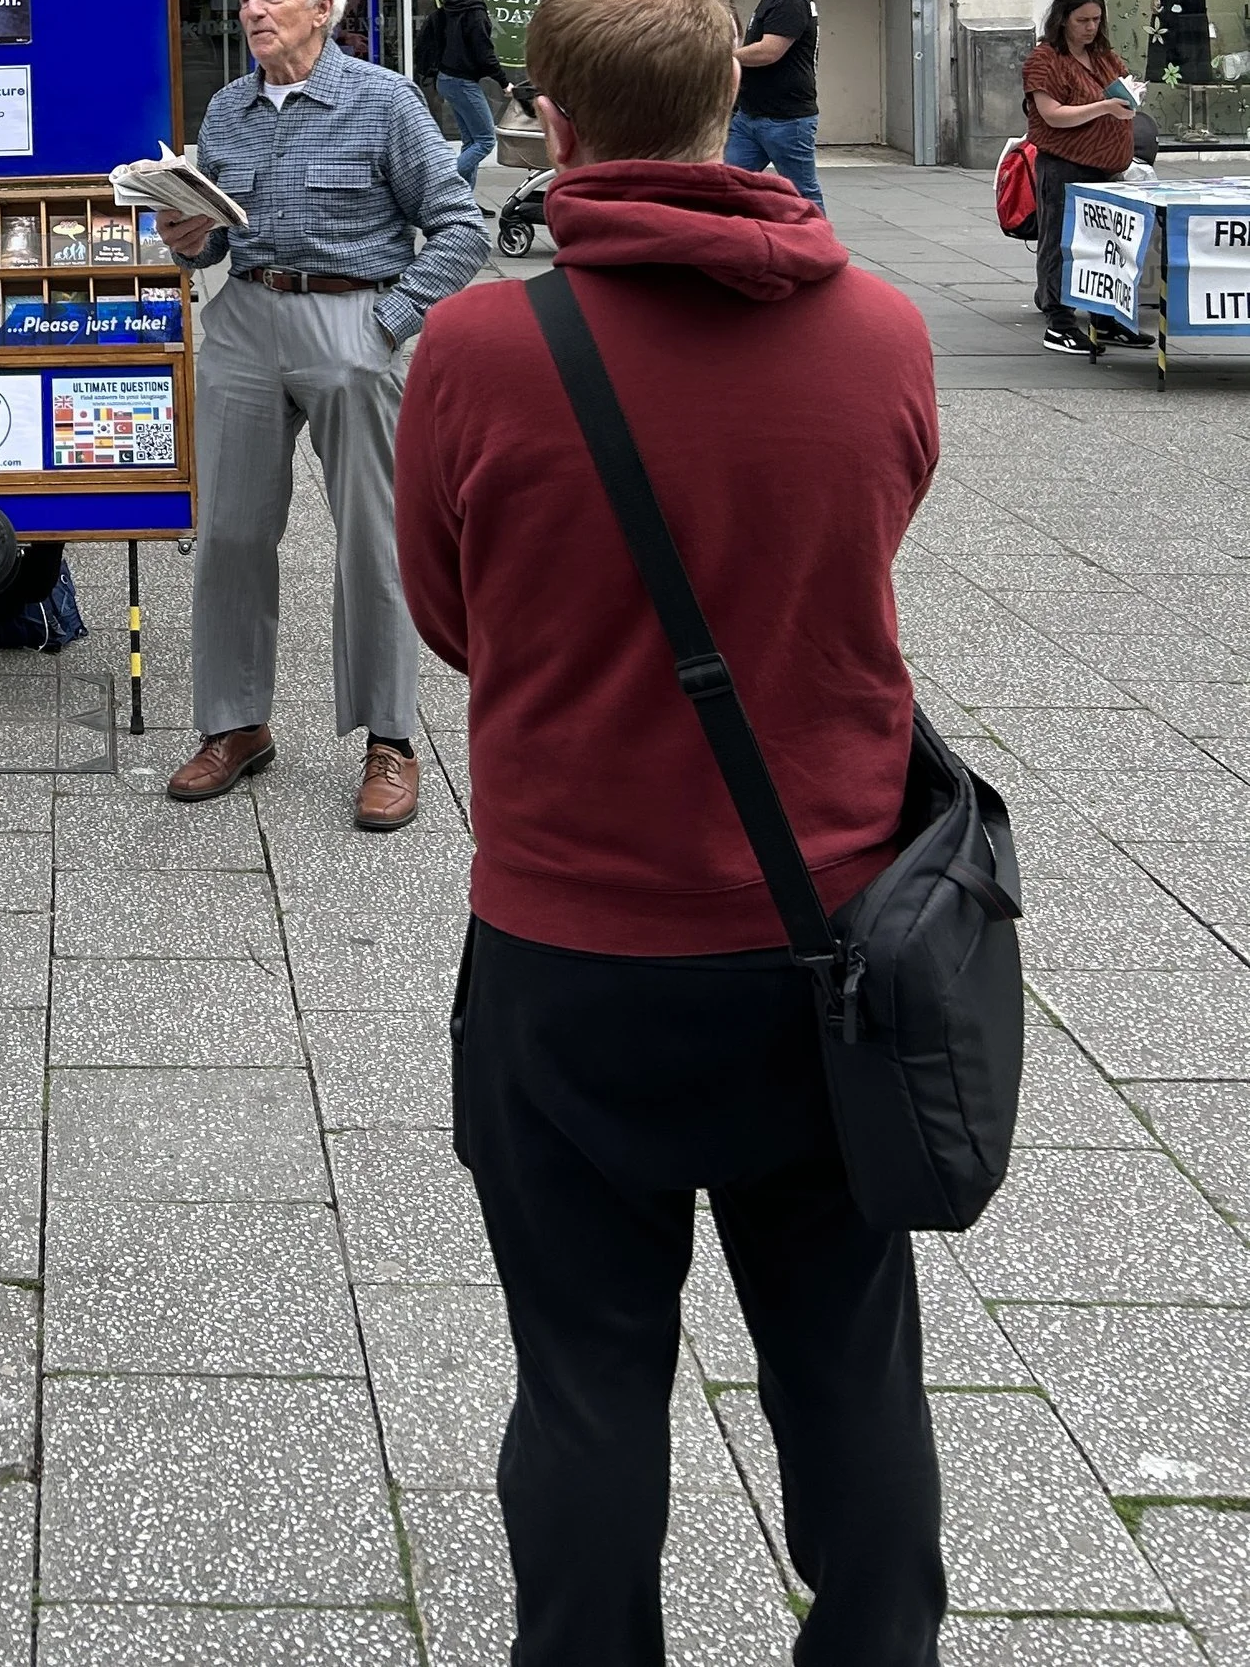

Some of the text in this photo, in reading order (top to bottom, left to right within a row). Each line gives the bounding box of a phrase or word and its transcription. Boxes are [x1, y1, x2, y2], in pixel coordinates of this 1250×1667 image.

[1083, 203, 1111, 231] FREE
[1214, 220, 1250, 247] FR
[1205, 292, 1250, 319] LIT
[7, 315, 167, 335] ...Please just take!
[73, 381, 170, 393] ULTIMATE QUESTIONS
